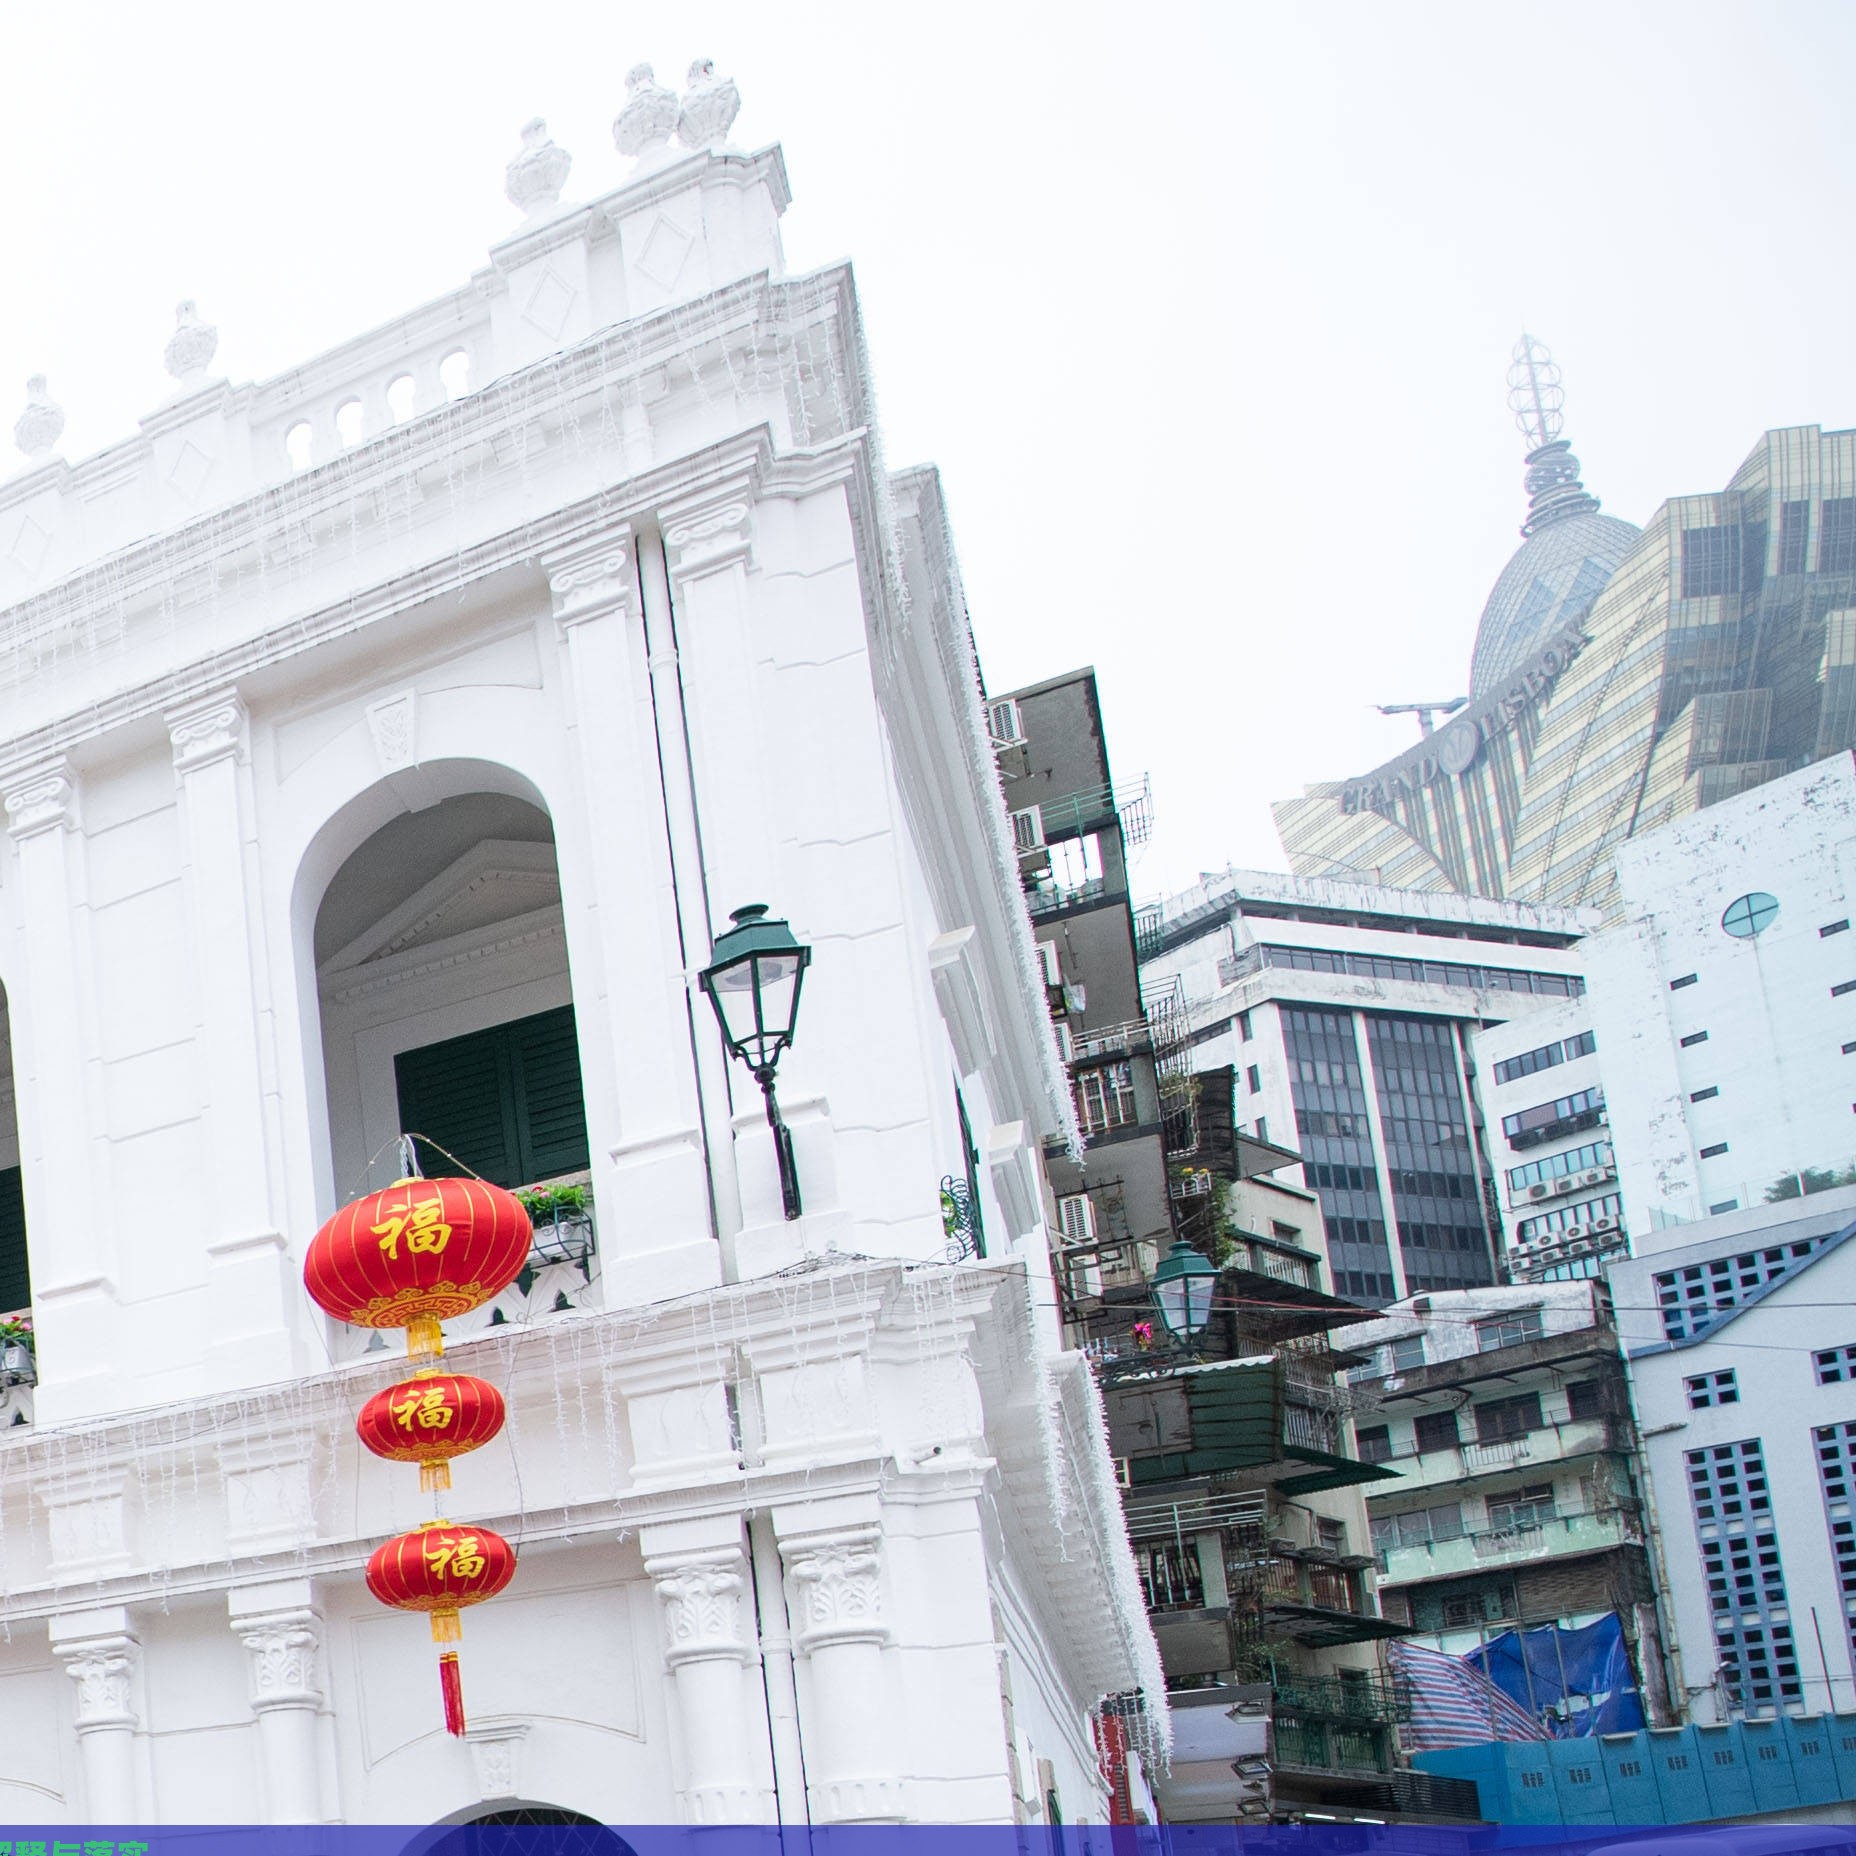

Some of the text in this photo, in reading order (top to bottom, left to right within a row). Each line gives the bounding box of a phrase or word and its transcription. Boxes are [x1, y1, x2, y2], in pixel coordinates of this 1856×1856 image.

[1339, 628, 1594, 816] GRAND LISBOA
[371, 1197, 453, 1261] 福
[393, 1386, 454, 1434] 福
[425, 1535, 486, 1581] 福
